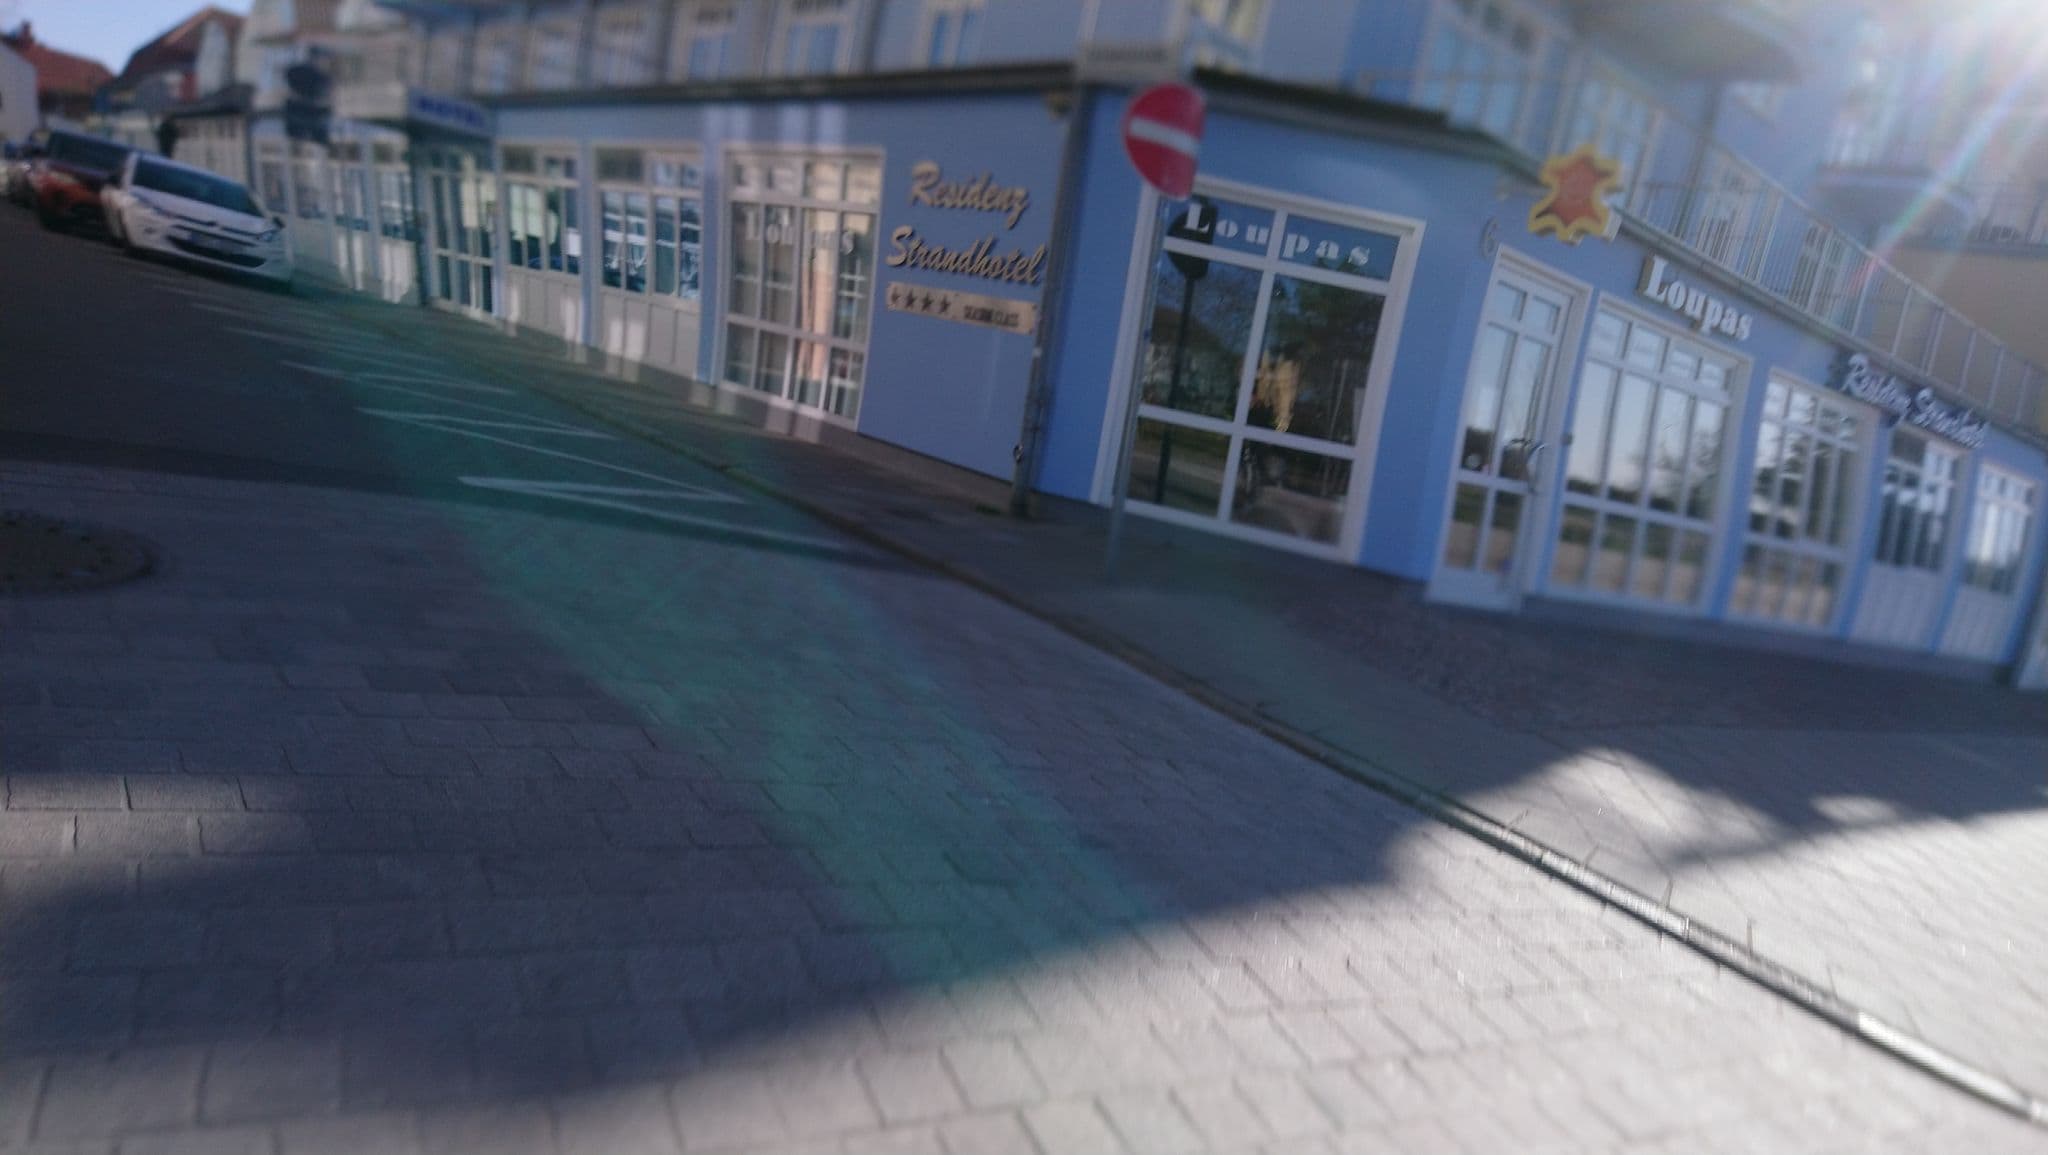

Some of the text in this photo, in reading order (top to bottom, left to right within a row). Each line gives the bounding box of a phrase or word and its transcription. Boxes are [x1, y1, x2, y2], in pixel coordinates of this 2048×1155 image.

[908, 159, 1029, 230] Residenz
[886, 225, 1048, 286] Strandhotel
[1185, 203, 1370, 266] Loupas
[1642, 254, 1753, 341] Loupas
